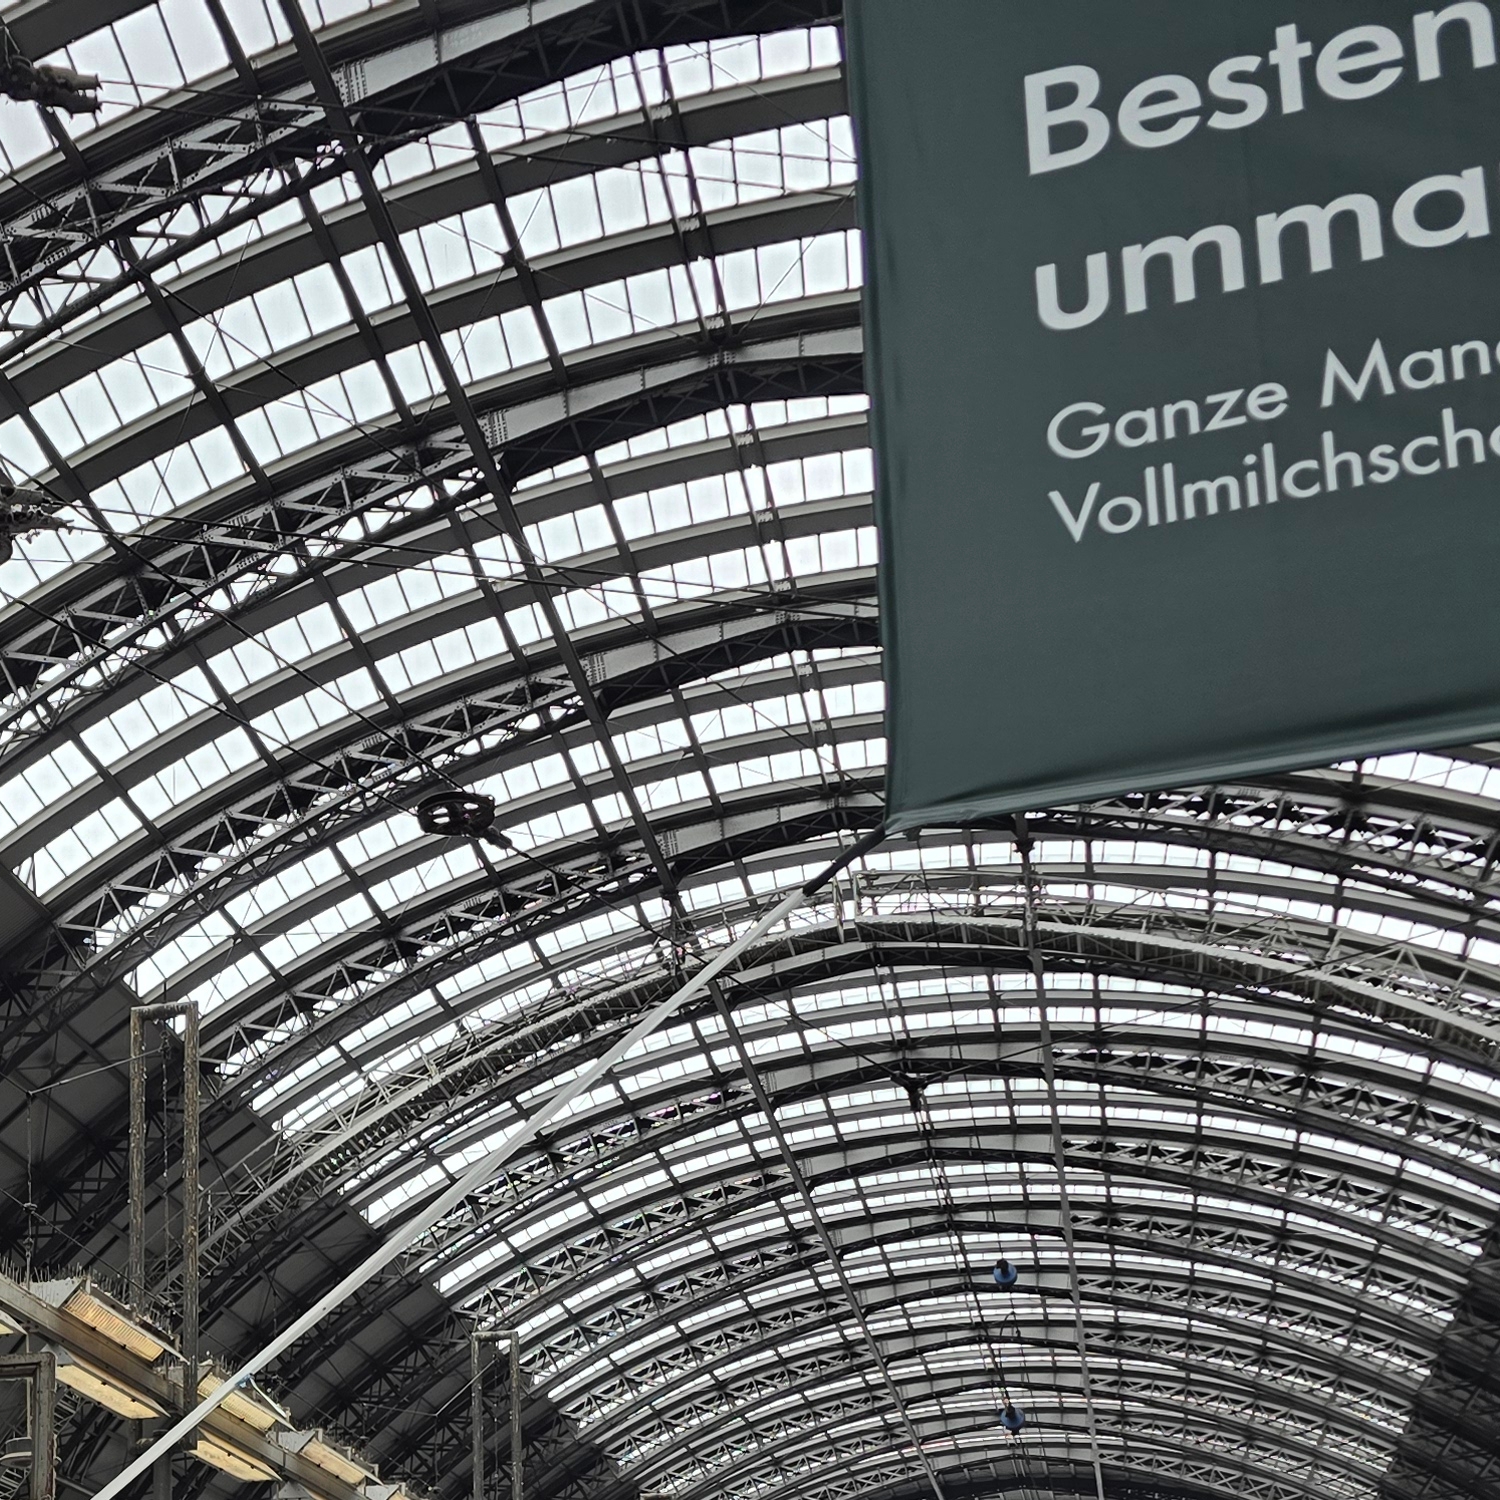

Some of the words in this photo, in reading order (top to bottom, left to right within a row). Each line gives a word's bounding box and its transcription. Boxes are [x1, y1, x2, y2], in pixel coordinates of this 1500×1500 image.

[1024, 1, 1497, 176] Besten
[1035, 165, 1500, 331] umma
[1046, 381, 1289, 459] Ganze
[1321, 337, 1500, 407] Man
